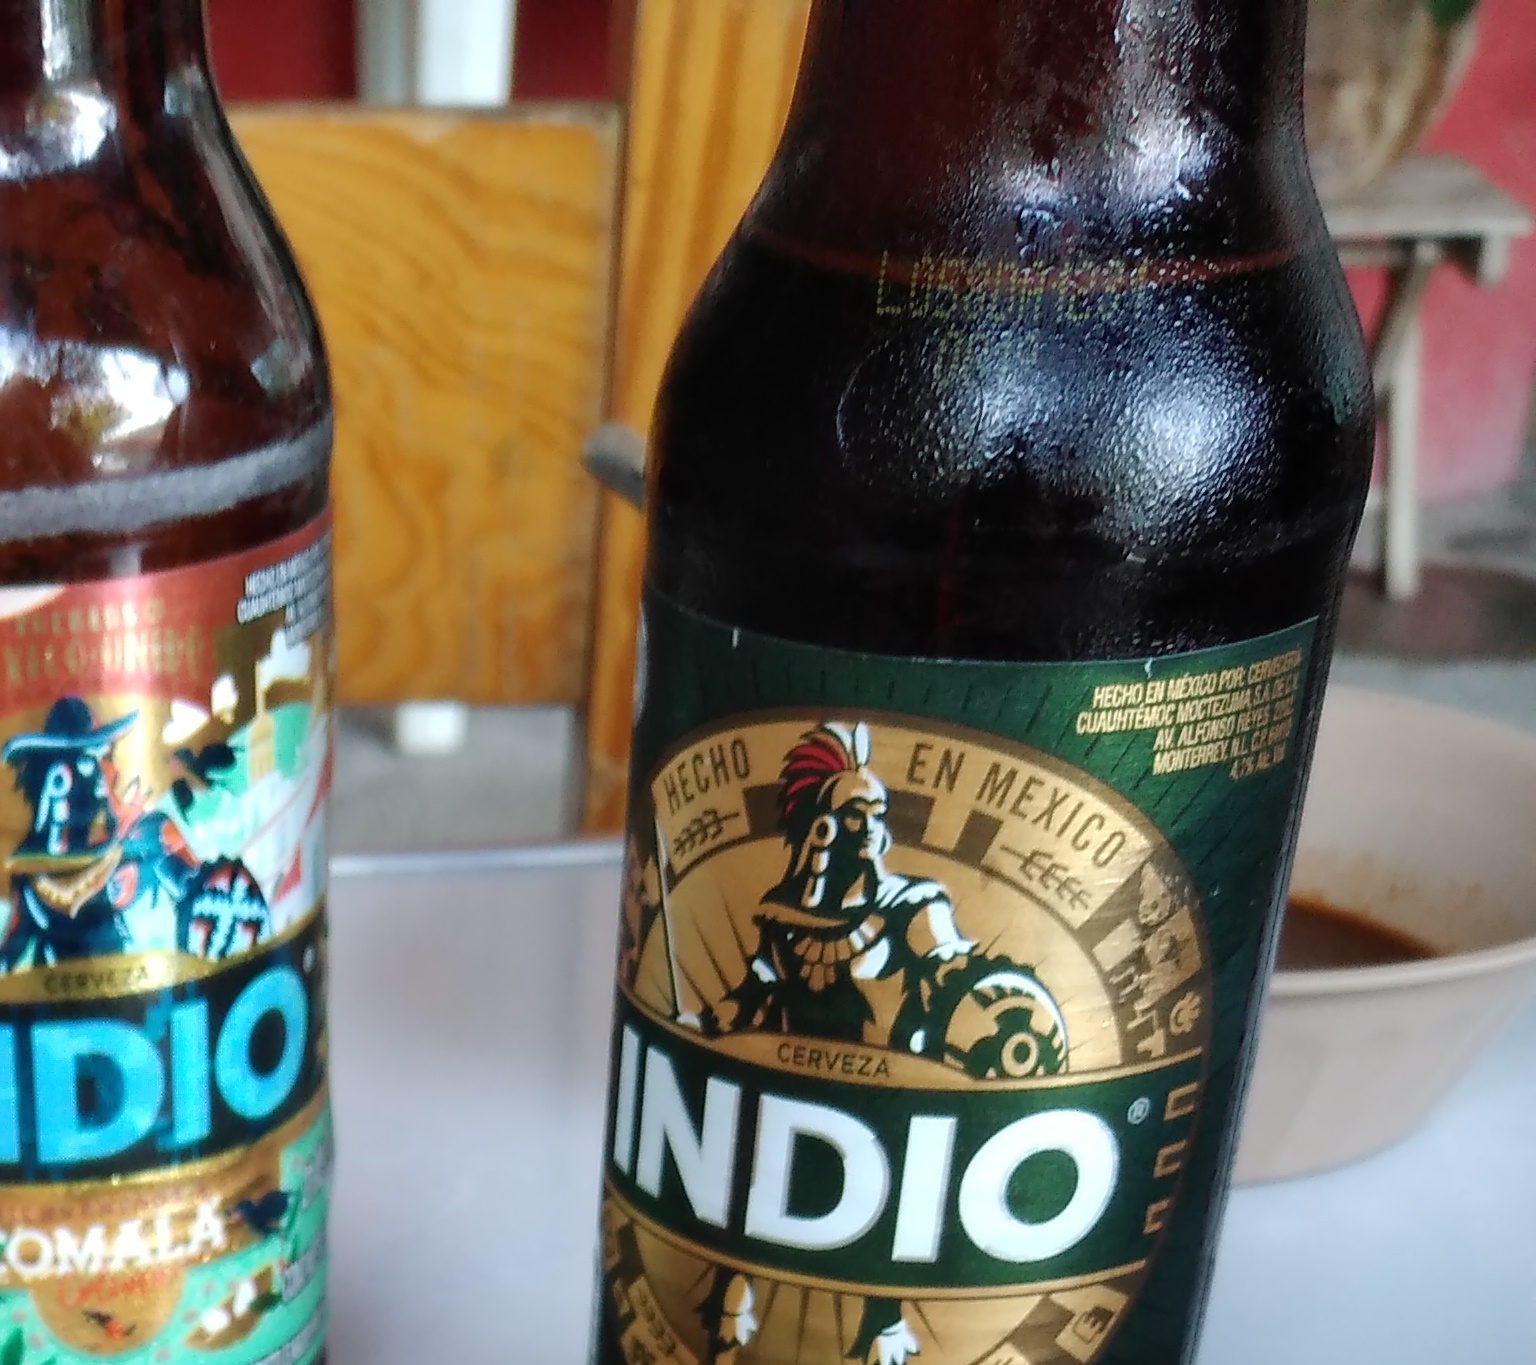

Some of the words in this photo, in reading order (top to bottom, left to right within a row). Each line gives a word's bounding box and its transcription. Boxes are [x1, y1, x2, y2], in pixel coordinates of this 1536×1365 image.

[1092, 682, 1143, 709] HECHO
[1145, 679, 1164, 703] EN
[1167, 672, 1217, 701] MÉXICO
[1076, 702, 1176, 735] CUAUHTÉMOC
[1153, 727, 1174, 751] AV.
[1178, 715, 1235, 748] ALFONSO
[663, 738, 751, 815] HECHO
[906, 742, 966, 791] EN
[977, 762, 1128, 869] MEXICO
[777, 1040, 891, 1079] CERVEZA
[613, 1022, 1120, 1263] INDIO
